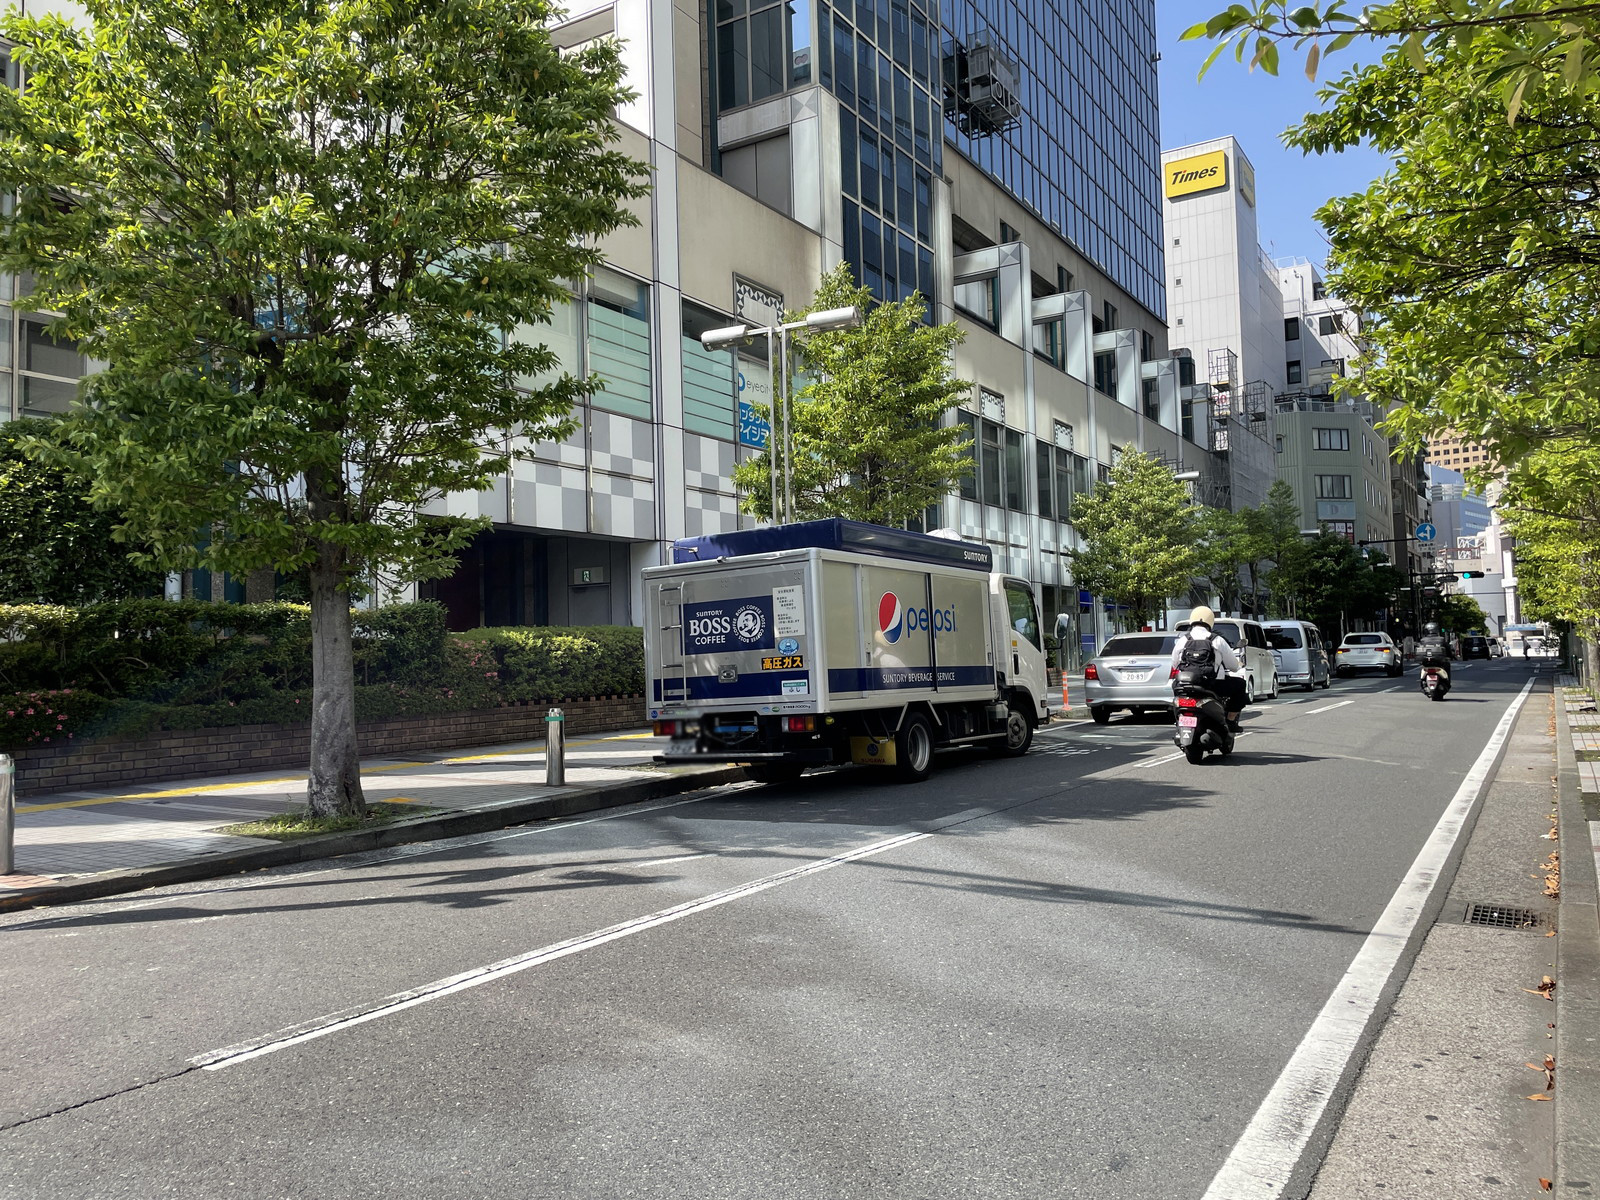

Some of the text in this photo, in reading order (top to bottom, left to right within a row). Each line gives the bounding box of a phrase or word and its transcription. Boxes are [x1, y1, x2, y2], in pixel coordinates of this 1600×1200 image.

[1171, 166, 1218, 185] Times
[746, 380, 770, 394] eyecit
[963, 550, 988, 563] SUNTORY
[735, 605, 746, 616] BOSS
[745, 604, 762, 615] COFFEE
[689, 616, 731, 636] BOSS
[906, 604, 957, 639] pepsi
[695, 635, 726, 645] COFFEE
[762, 656, 803, 670] 高圧ガス
[882, 671, 956, 684] SUNTORY BEVERAGE SERVICE
